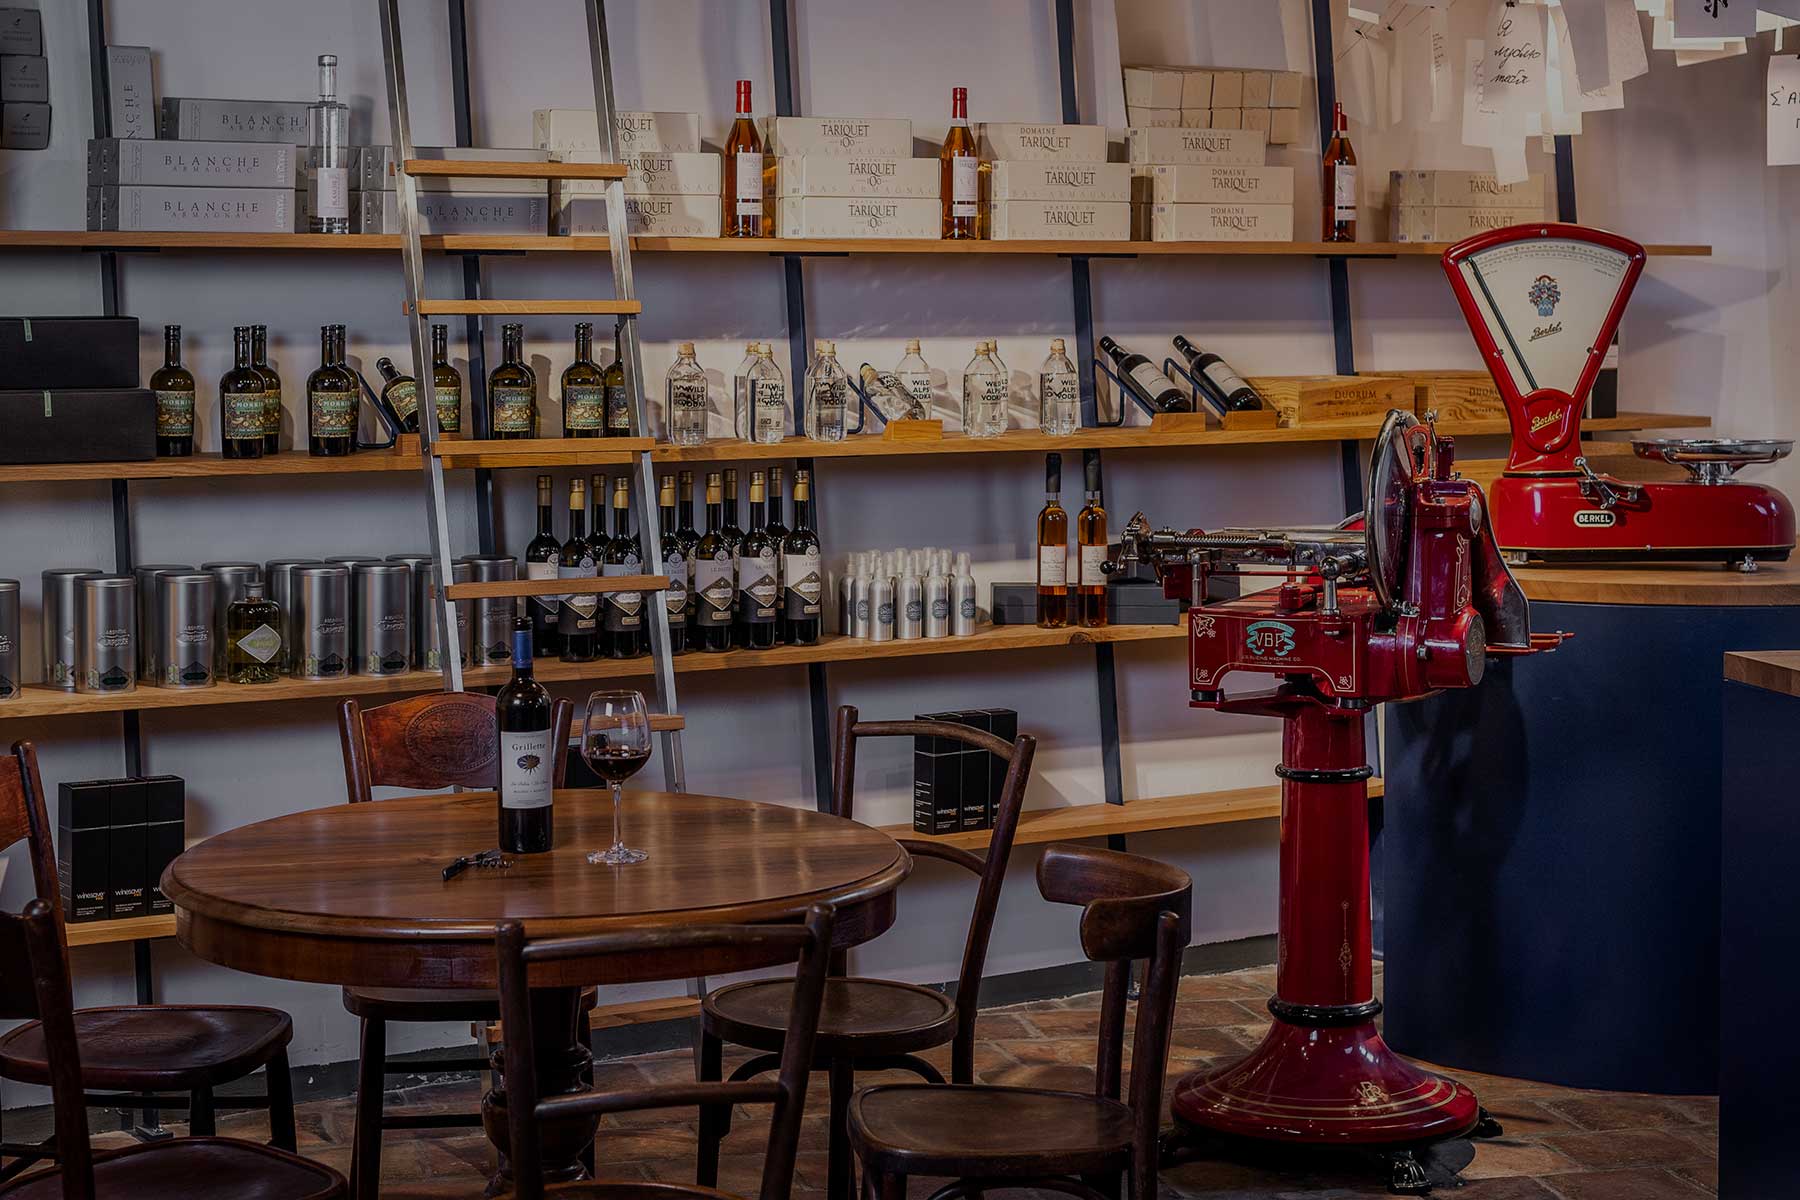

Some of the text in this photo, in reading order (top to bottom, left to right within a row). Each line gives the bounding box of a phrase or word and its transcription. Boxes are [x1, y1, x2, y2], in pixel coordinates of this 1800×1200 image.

[615, 119, 653, 132] RIQUET
[821, 124, 870, 138] TARIQUET
[1020, 127, 1057, 135] DOMAINE
[1019, 136, 1071, 152] TARIQUET
[1182, 137, 1231, 152] TARIQUET
[164, 155, 260, 168] BLANCHE
[848, 162, 897, 177] TARIQUET
[1045, 171, 1096, 187] TARIQUET
[1212, 178, 1260, 193] TARIQUET
[163, 201, 259, 213] BLANCHE
[426, 206, 514, 217] BLANCHE
[848, 204, 898, 219] TARIQUET
[1210, 207, 1244, 215] DOMAINE
[1044, 211, 1096, 227] TARIQUET
[1210, 216, 1258, 231] TARIQUET
[1468, 215, 1513, 228] TARIQUET
[1529, 321, 1562, 342] Berkel
[1334, 390, 1377, 399] DUORUM
[1531, 408, 1562, 432] Berkel
[1578, 514, 1610, 523] BERKEL
[511, 743, 546, 752] Grillette
[76, 890, 106, 899] winesaver
